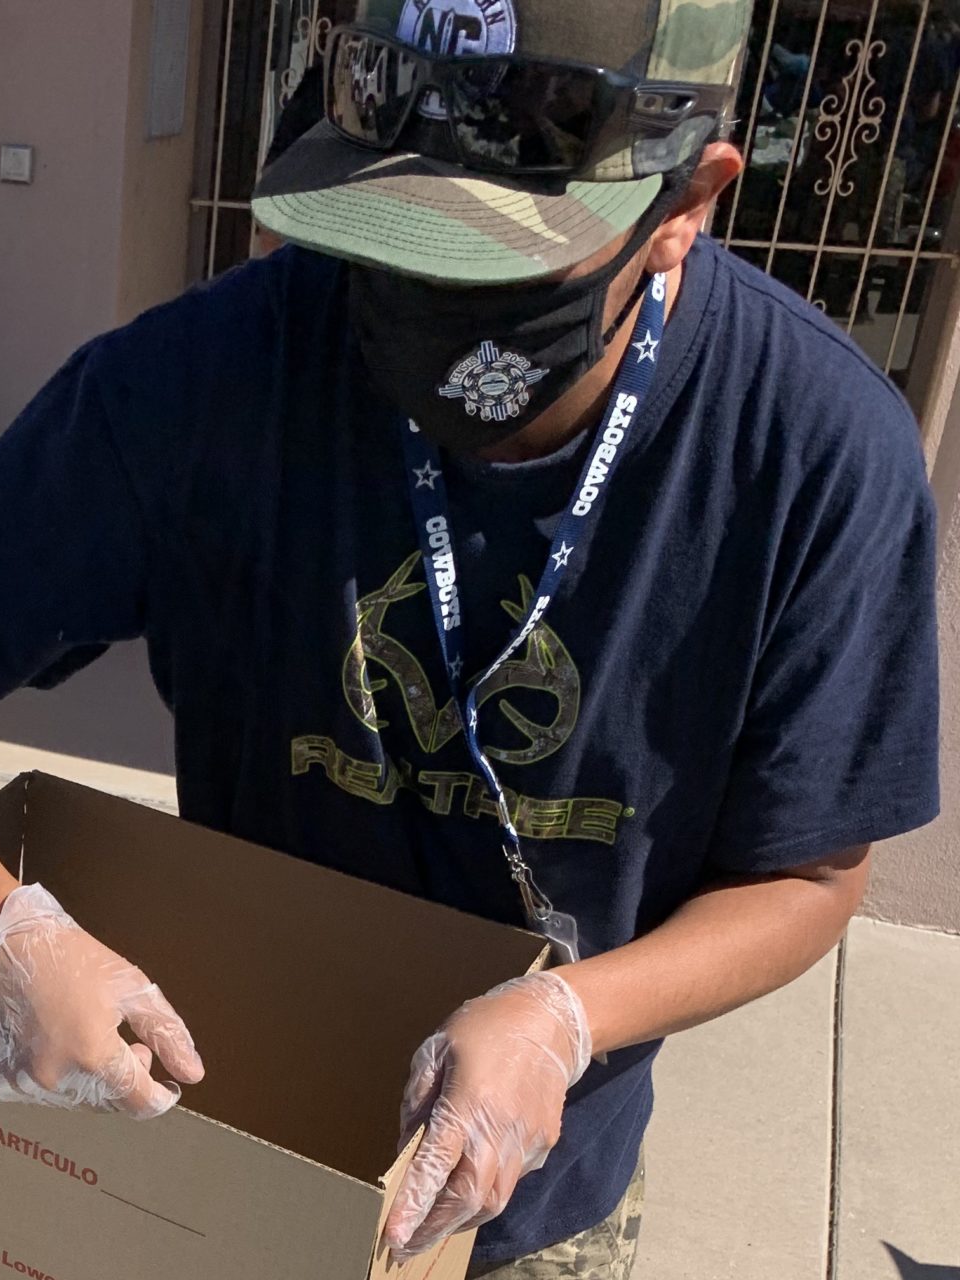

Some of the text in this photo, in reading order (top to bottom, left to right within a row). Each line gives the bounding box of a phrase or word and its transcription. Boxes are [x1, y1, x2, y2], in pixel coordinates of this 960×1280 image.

[449, 352, 531, 384] CENSUS 2020
[572, 393, 637, 517] COWBOYS
[426, 515, 461, 631] COWBOYS
